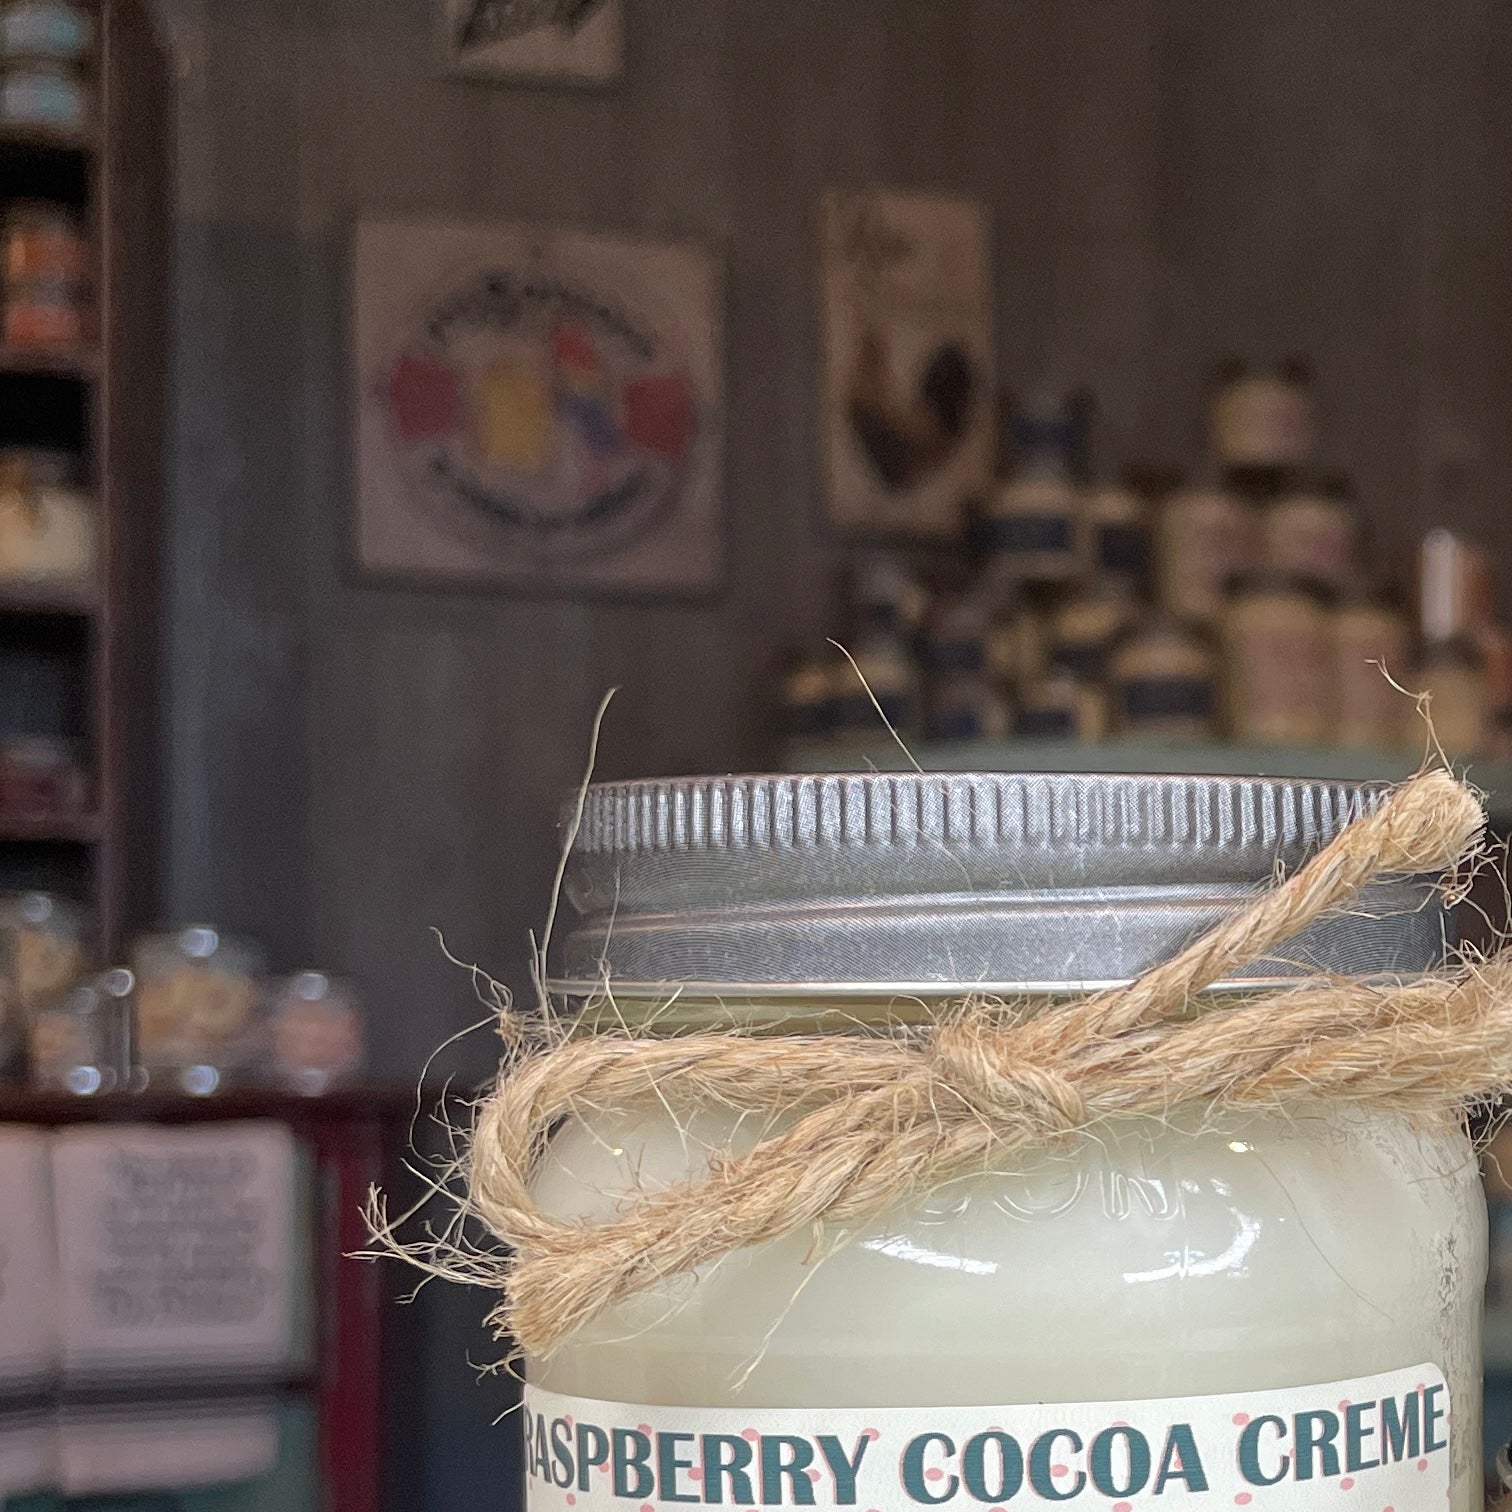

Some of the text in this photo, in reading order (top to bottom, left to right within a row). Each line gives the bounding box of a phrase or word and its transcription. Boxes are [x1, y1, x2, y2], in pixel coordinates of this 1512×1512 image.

[523, 1384, 1449, 1506] RASPBERRY COCOA CREME
